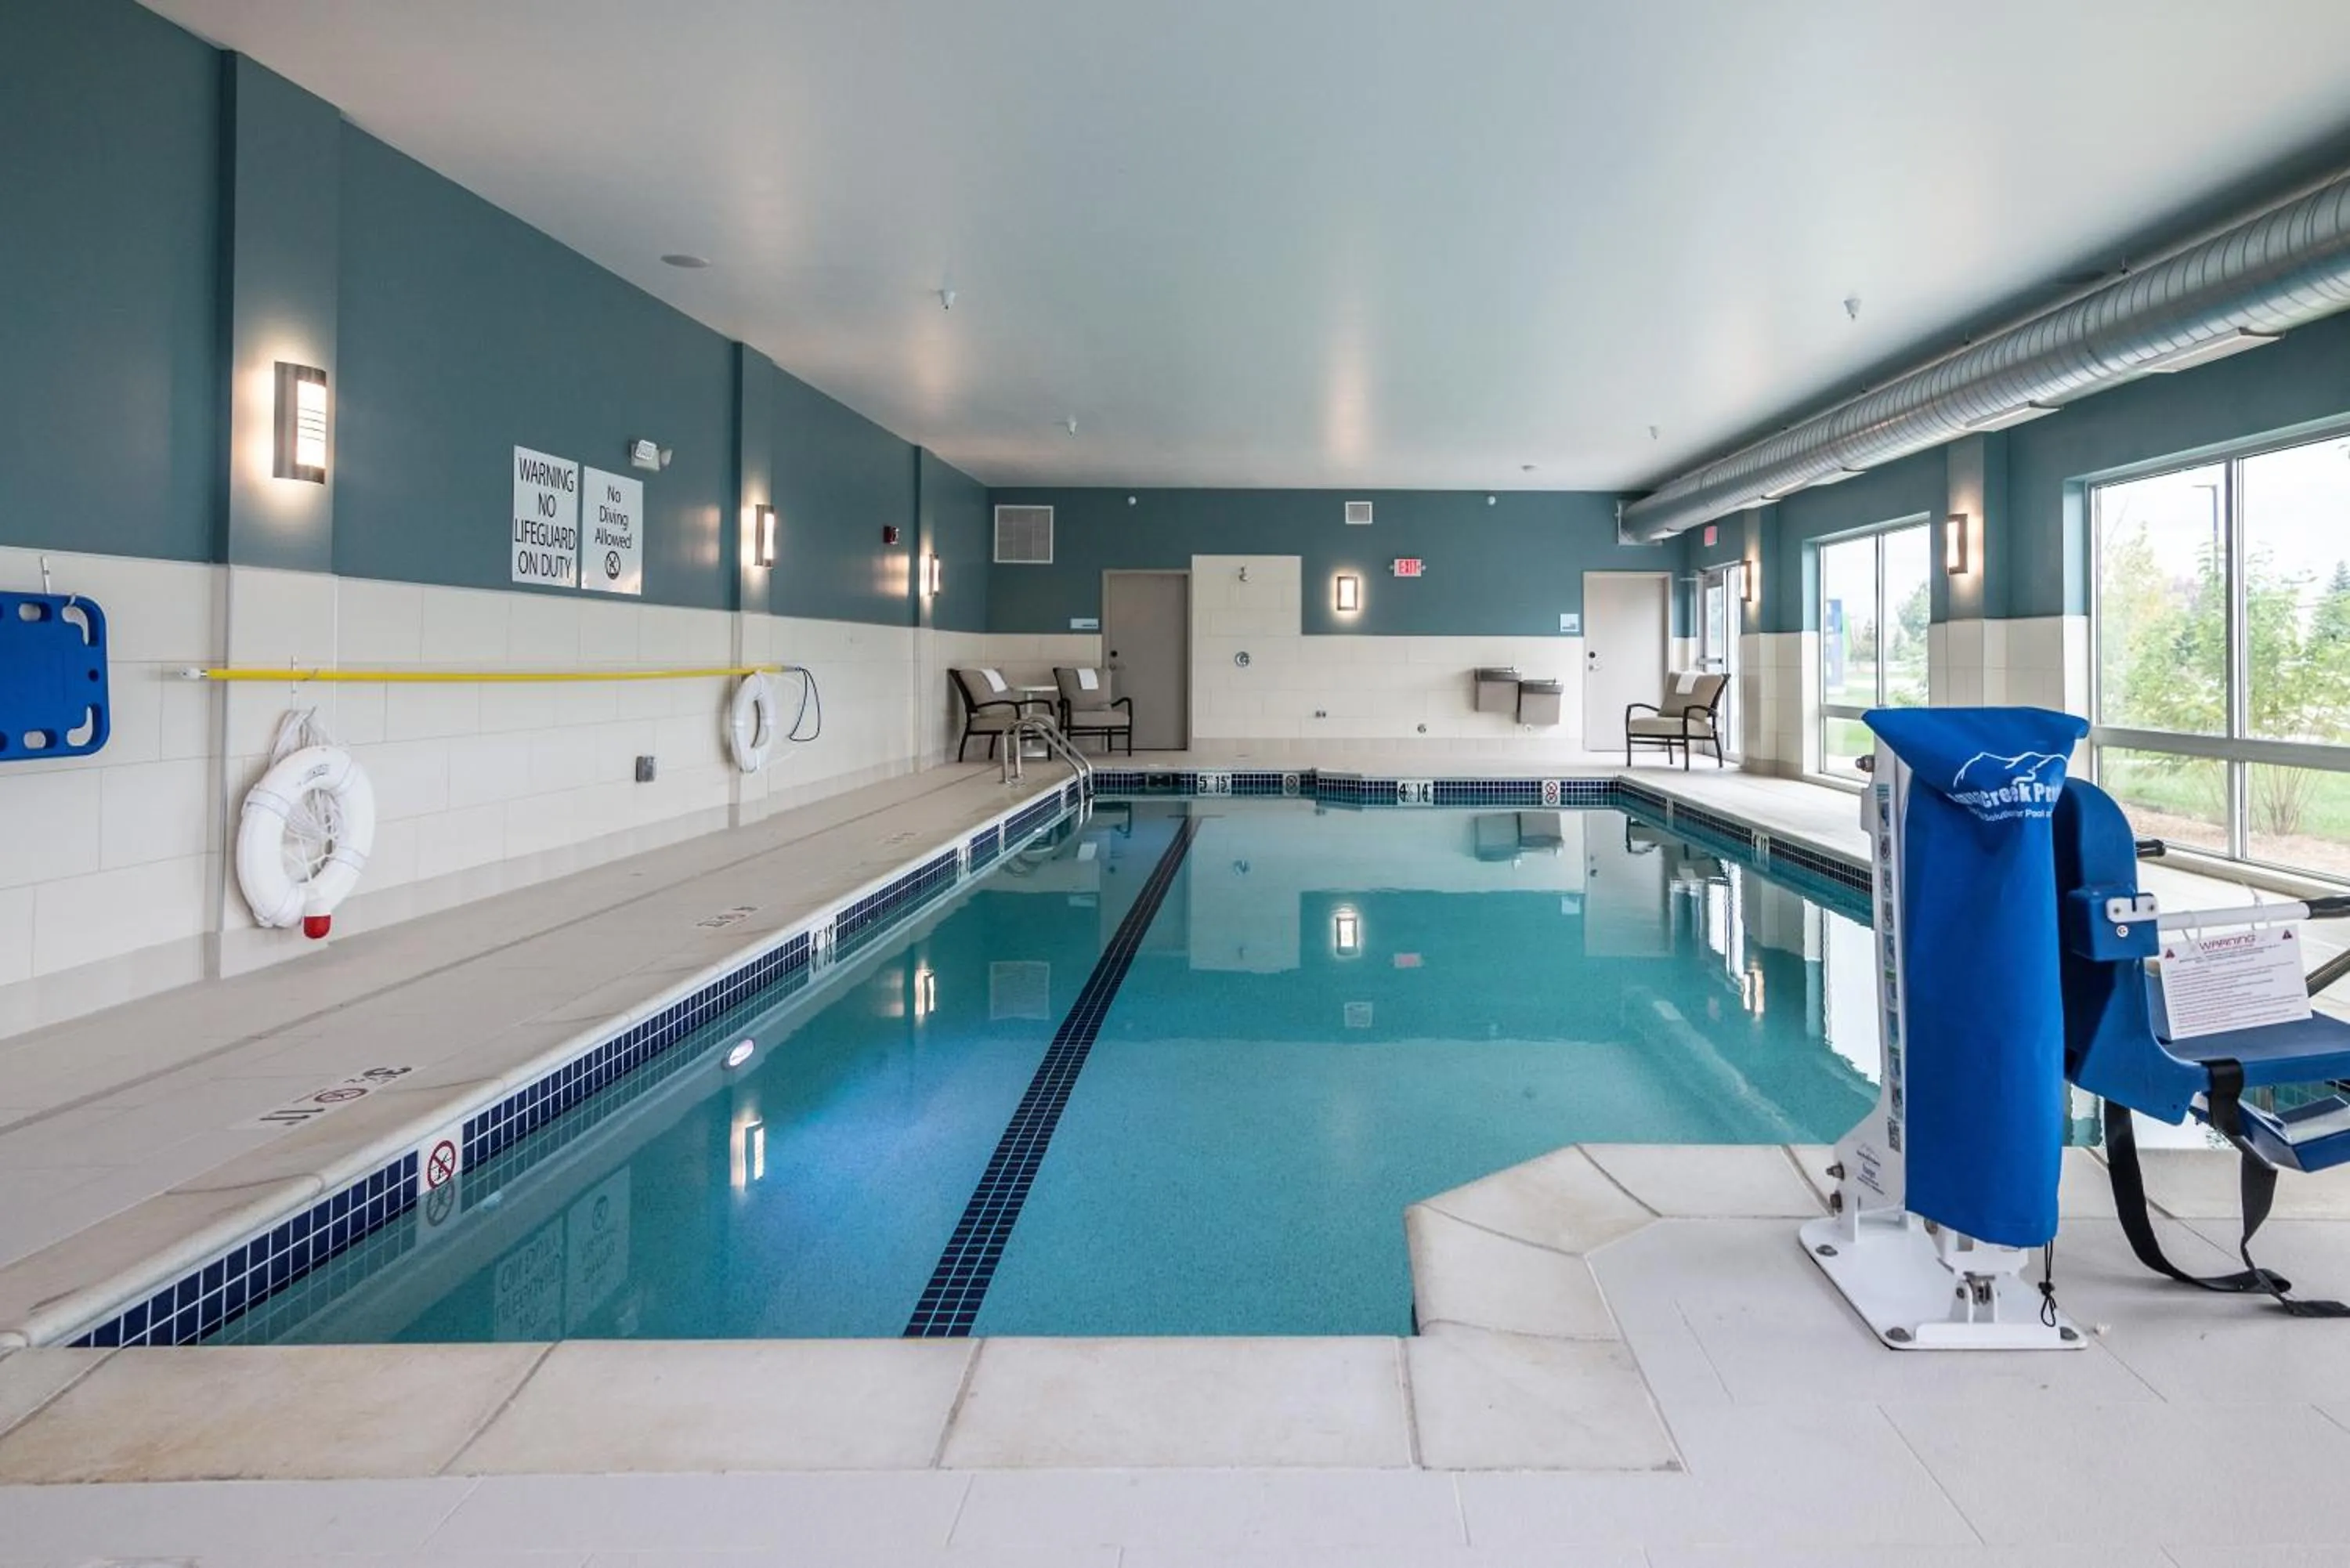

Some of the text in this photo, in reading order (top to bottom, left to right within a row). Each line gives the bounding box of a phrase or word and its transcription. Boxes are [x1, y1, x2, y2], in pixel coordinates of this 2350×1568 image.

[519, 457, 574, 493] WARNING
[538, 493, 557, 518] NO
[607, 484, 621, 504] No
[599, 505, 629, 531] Diving
[515, 518, 576, 551] LIFEGUARD
[595, 528, 632, 549] Allowed
[518, 551, 572, 579] ON DUTY
[1398, 560, 1417, 574] EXIT
